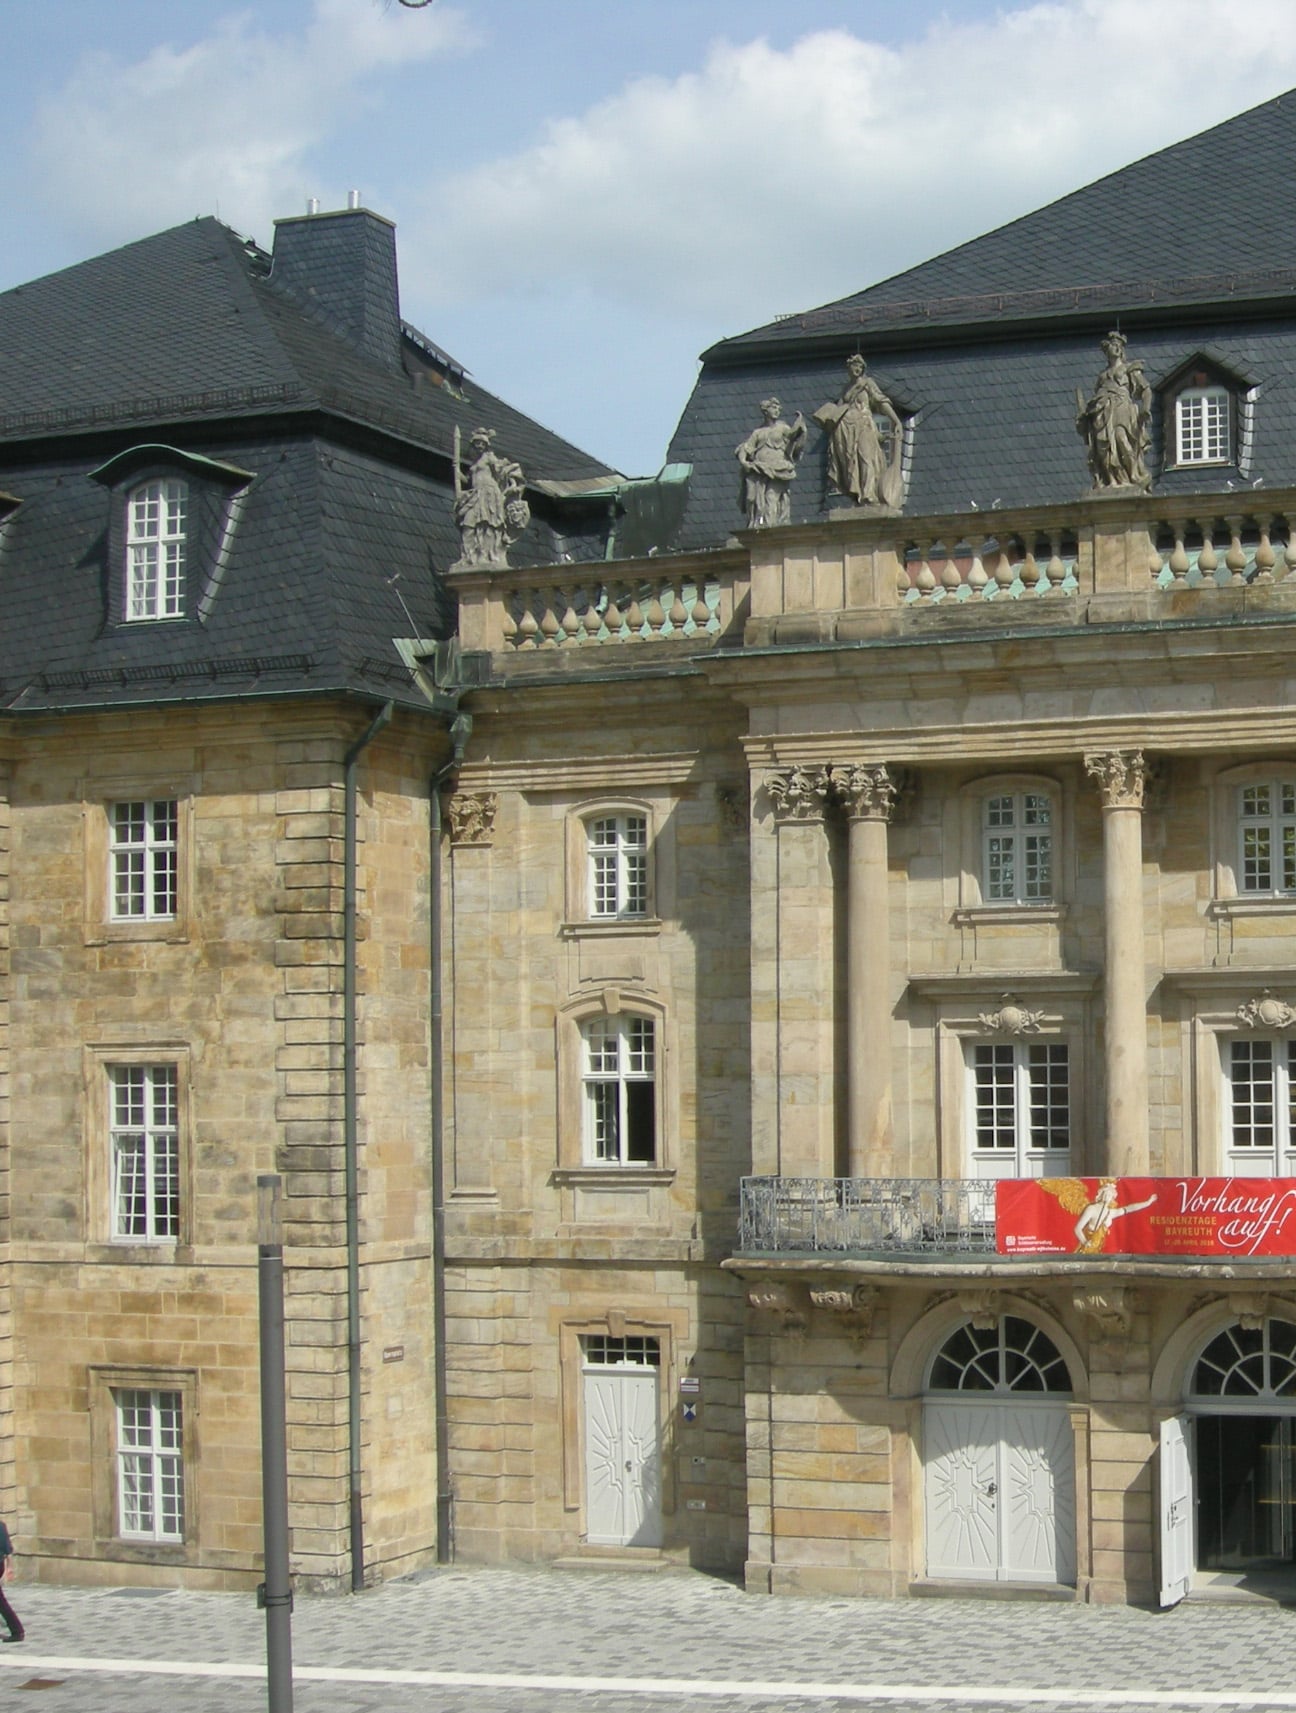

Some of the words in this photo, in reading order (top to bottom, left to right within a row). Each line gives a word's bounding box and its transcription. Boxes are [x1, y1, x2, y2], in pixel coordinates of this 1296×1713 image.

[1175, 1178, 1277, 1222] Vorhang
[1149, 1215, 1217, 1226] RESIDENZTAGE
[1164, 1226, 1213, 1236] BAYREUTH
